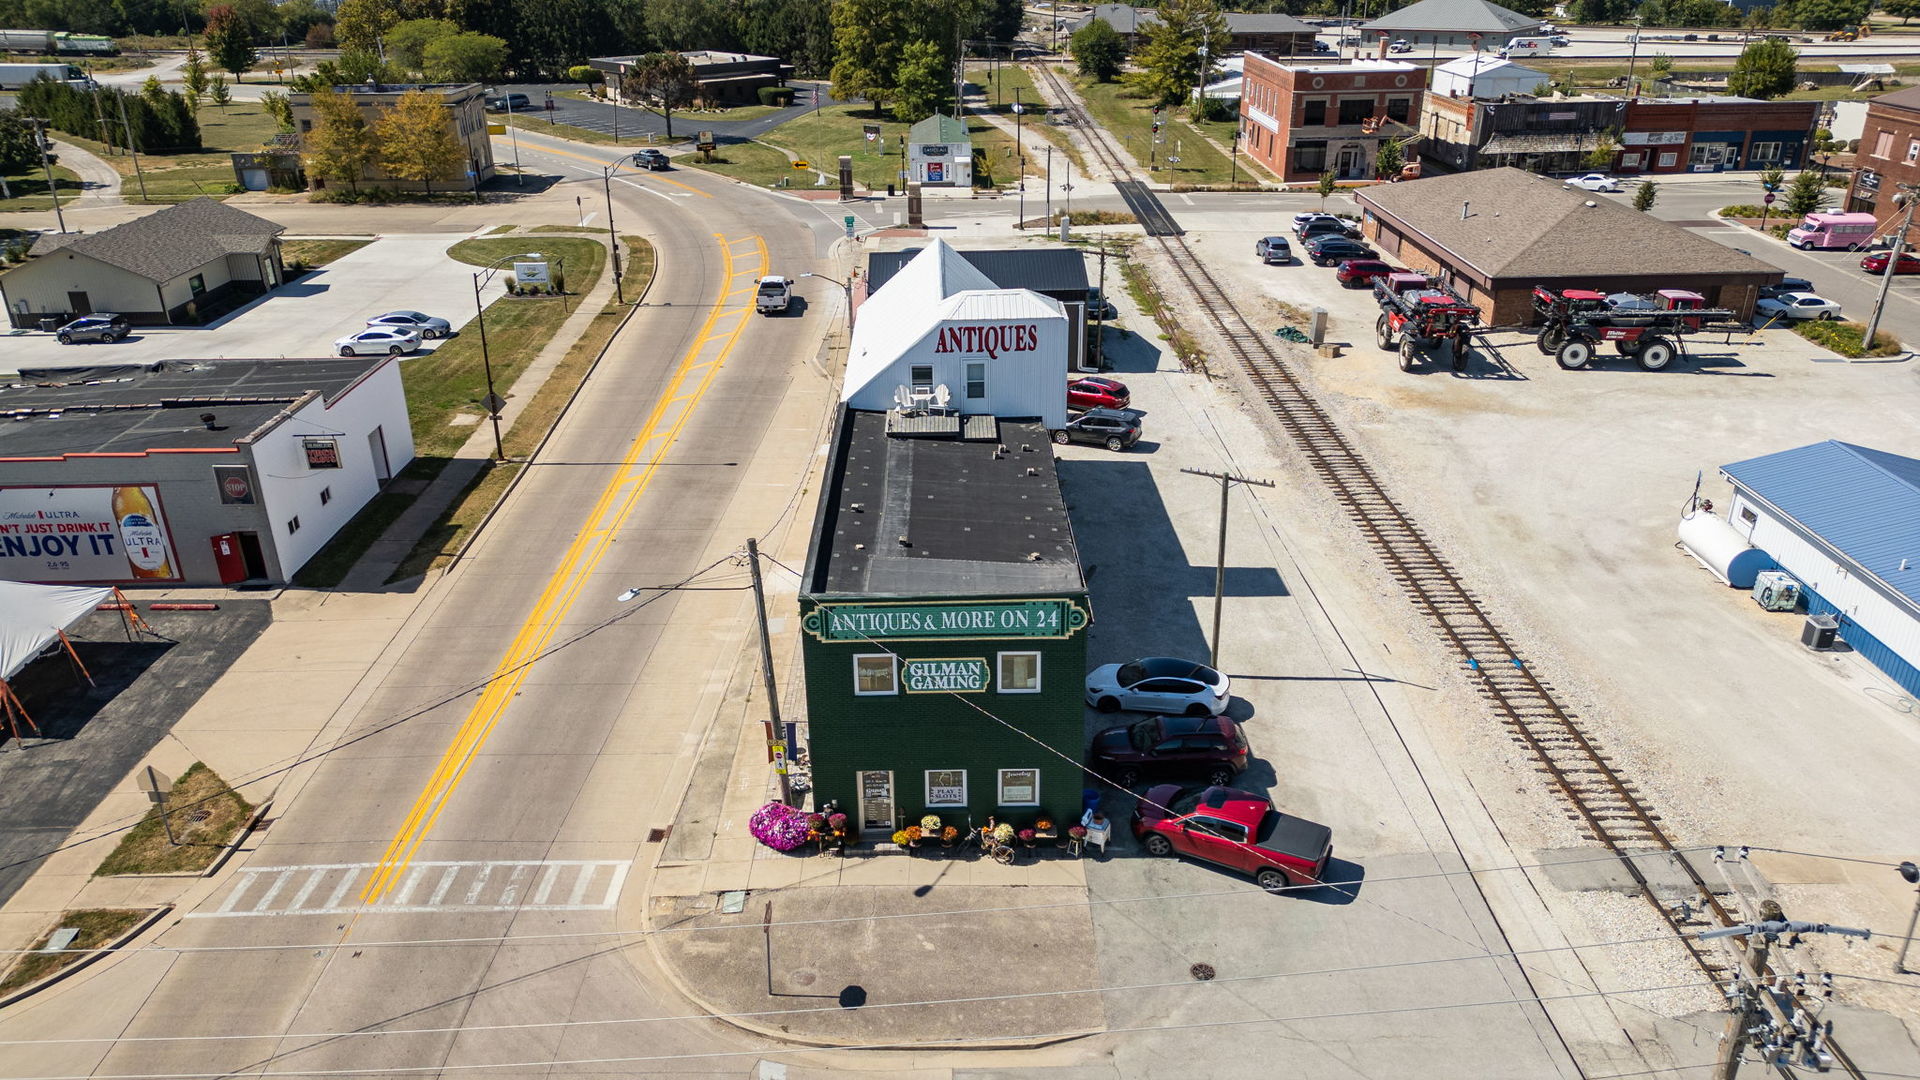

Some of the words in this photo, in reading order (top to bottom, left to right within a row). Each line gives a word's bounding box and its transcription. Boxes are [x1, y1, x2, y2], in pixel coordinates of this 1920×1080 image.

[935, 324, 1038, 360] ANTIQUES
[225, 483, 246, 492] STOP
[45, 511, 80, 519] ULTRA
[24, 523, 53, 534] JUST
[57, 523, 97, 534] DRINK
[99, 522, 110, 533] IT
[88, 534, 114, 556] IT
[124, 536, 161, 546] ULTRA
[831, 611, 921, 635] ANTIQUES
[924, 614, 937, 630] &
[941, 610, 995, 630] MORE
[1001, 609, 1030, 628] ON
[1036, 609, 1059, 628] 24
[909, 662, 981, 676] GILMAN
[910, 675, 981, 690] GAMING
